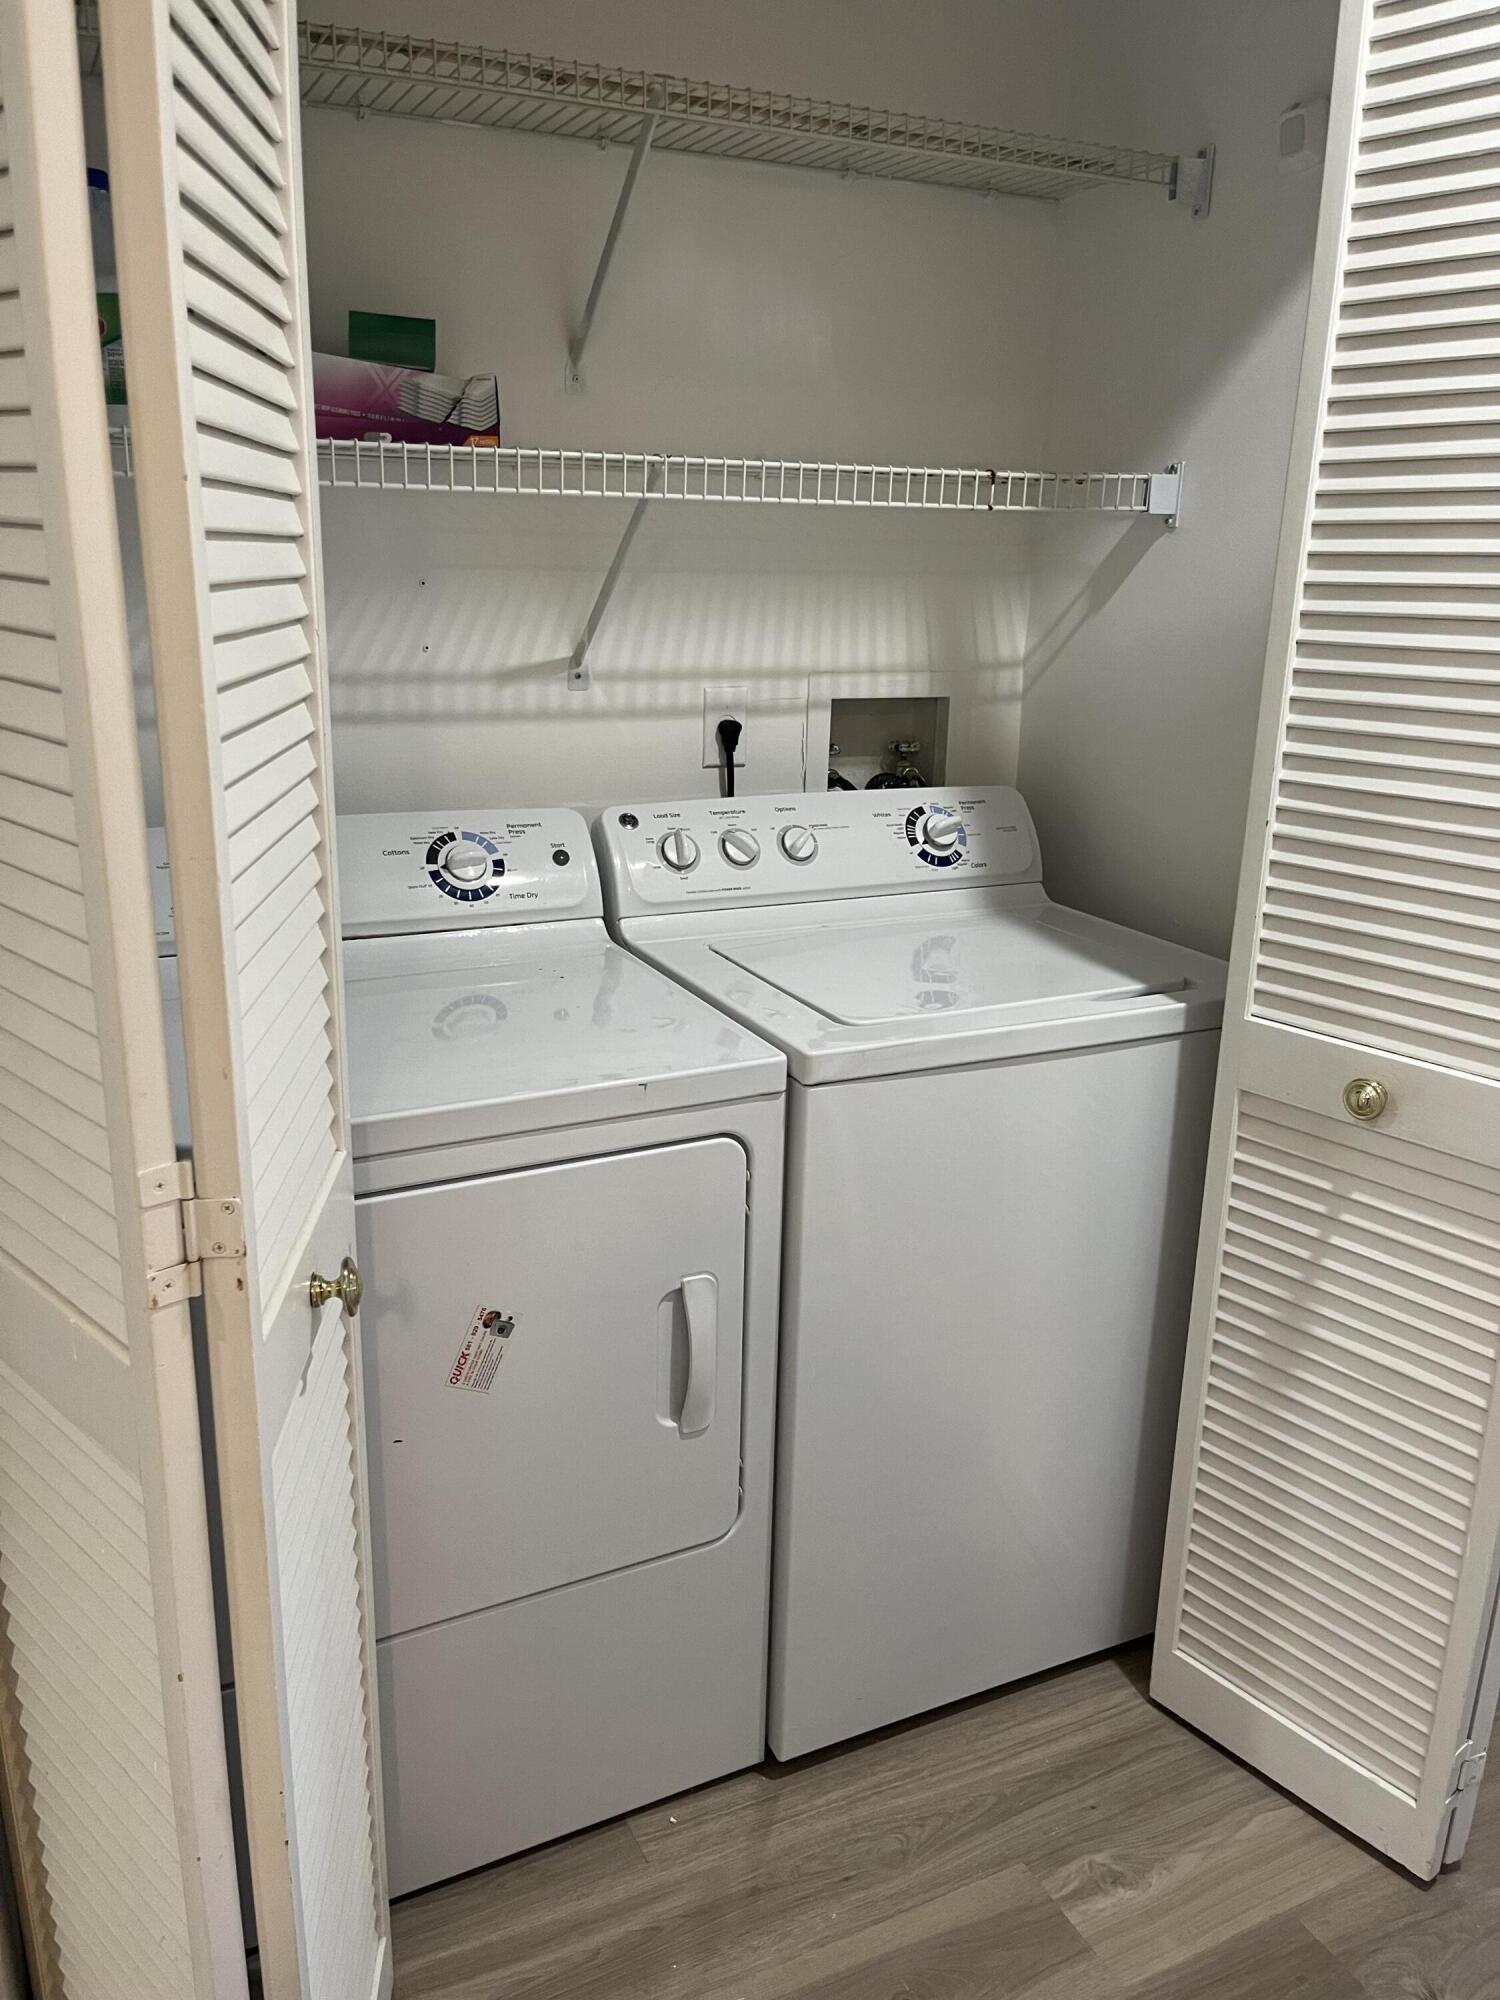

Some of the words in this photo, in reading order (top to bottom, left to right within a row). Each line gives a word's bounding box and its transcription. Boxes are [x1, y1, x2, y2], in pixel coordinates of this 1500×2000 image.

[506, 822, 542, 830] Permanent
[971, 861, 988, 869] Colors
[449, 1351, 470, 1385] QUICK
